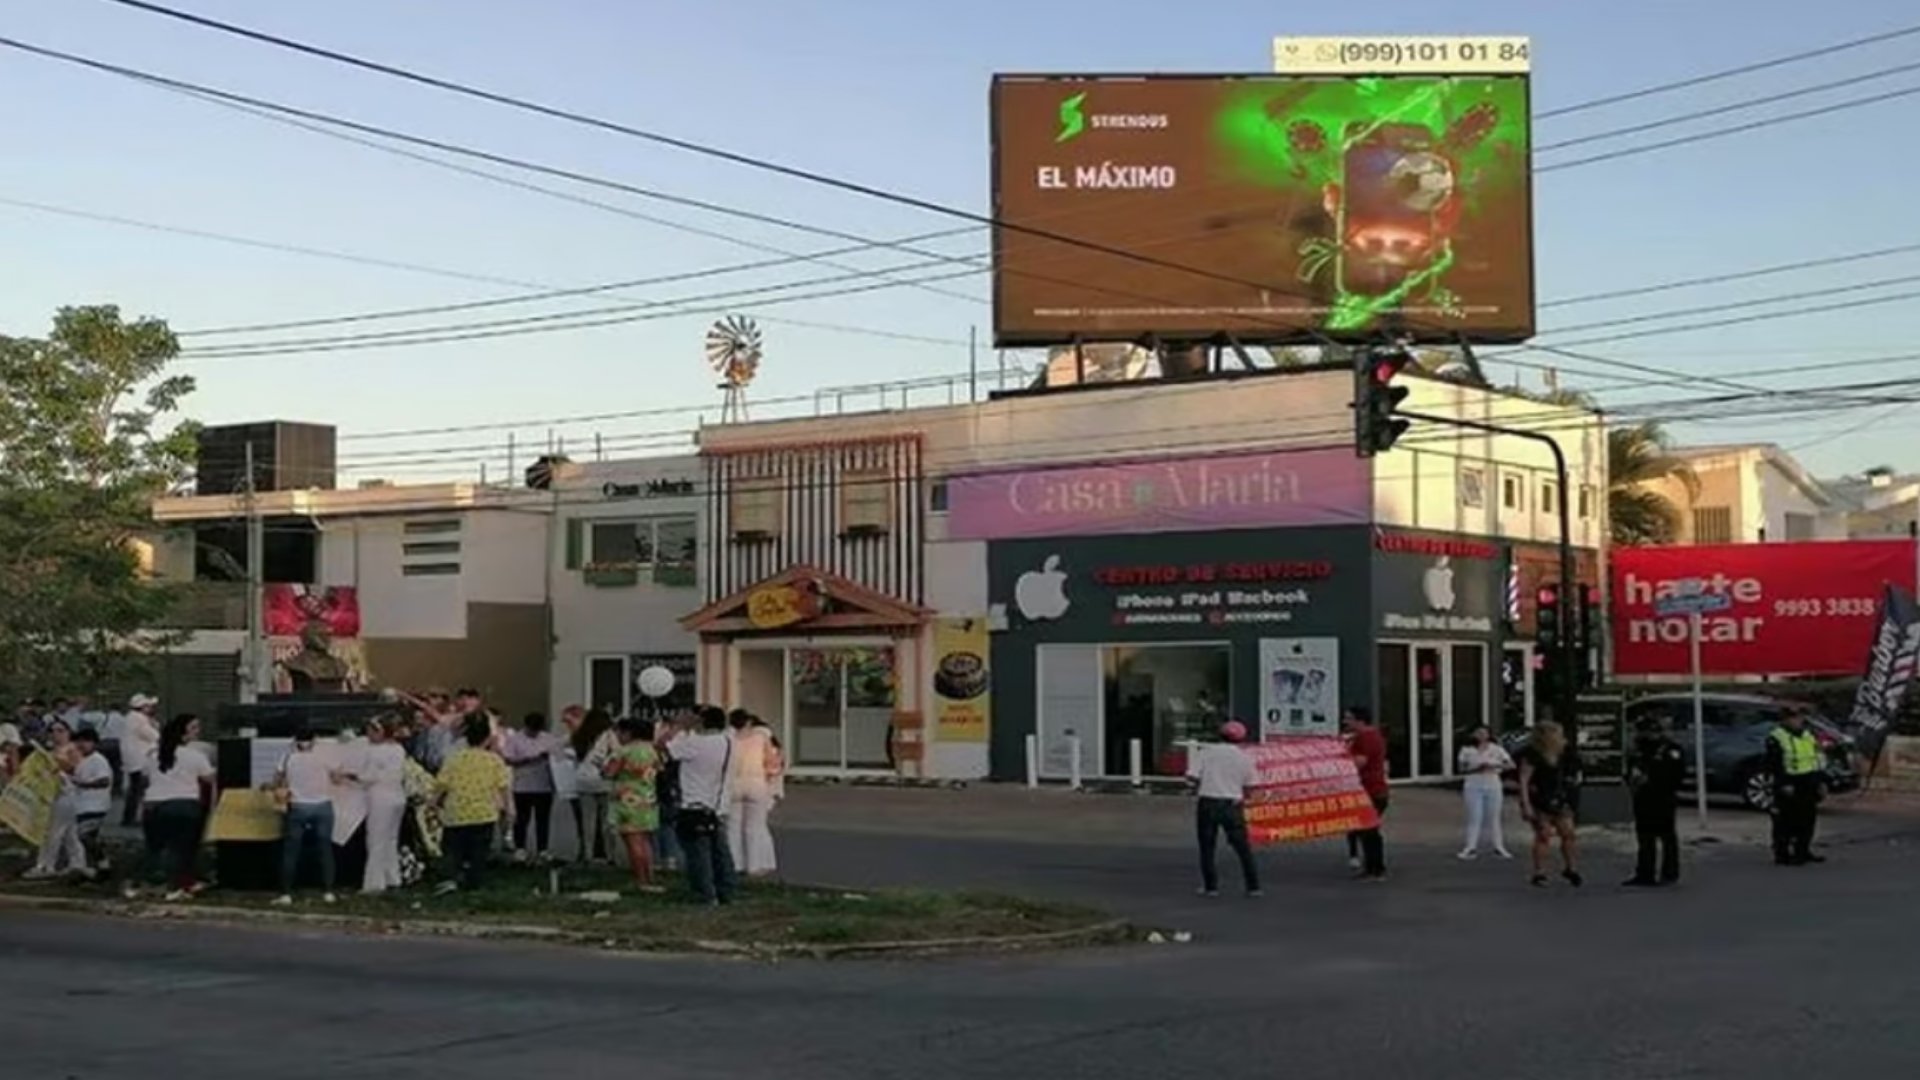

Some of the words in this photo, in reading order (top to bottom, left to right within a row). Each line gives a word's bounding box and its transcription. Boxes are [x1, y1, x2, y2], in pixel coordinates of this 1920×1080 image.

[1340, 42, 1448, 64] (999)101
[1458, 43, 1488, 60] 01
[1500, 43, 1529, 60] 84
[1038, 166, 1067, 188] EL
[1075, 161, 1175, 188] MÁXIMO
[1009, 472, 1122, 515] Casa
[1625, 573, 1762, 605] hate
[1773, 599, 1821, 616] 9993
